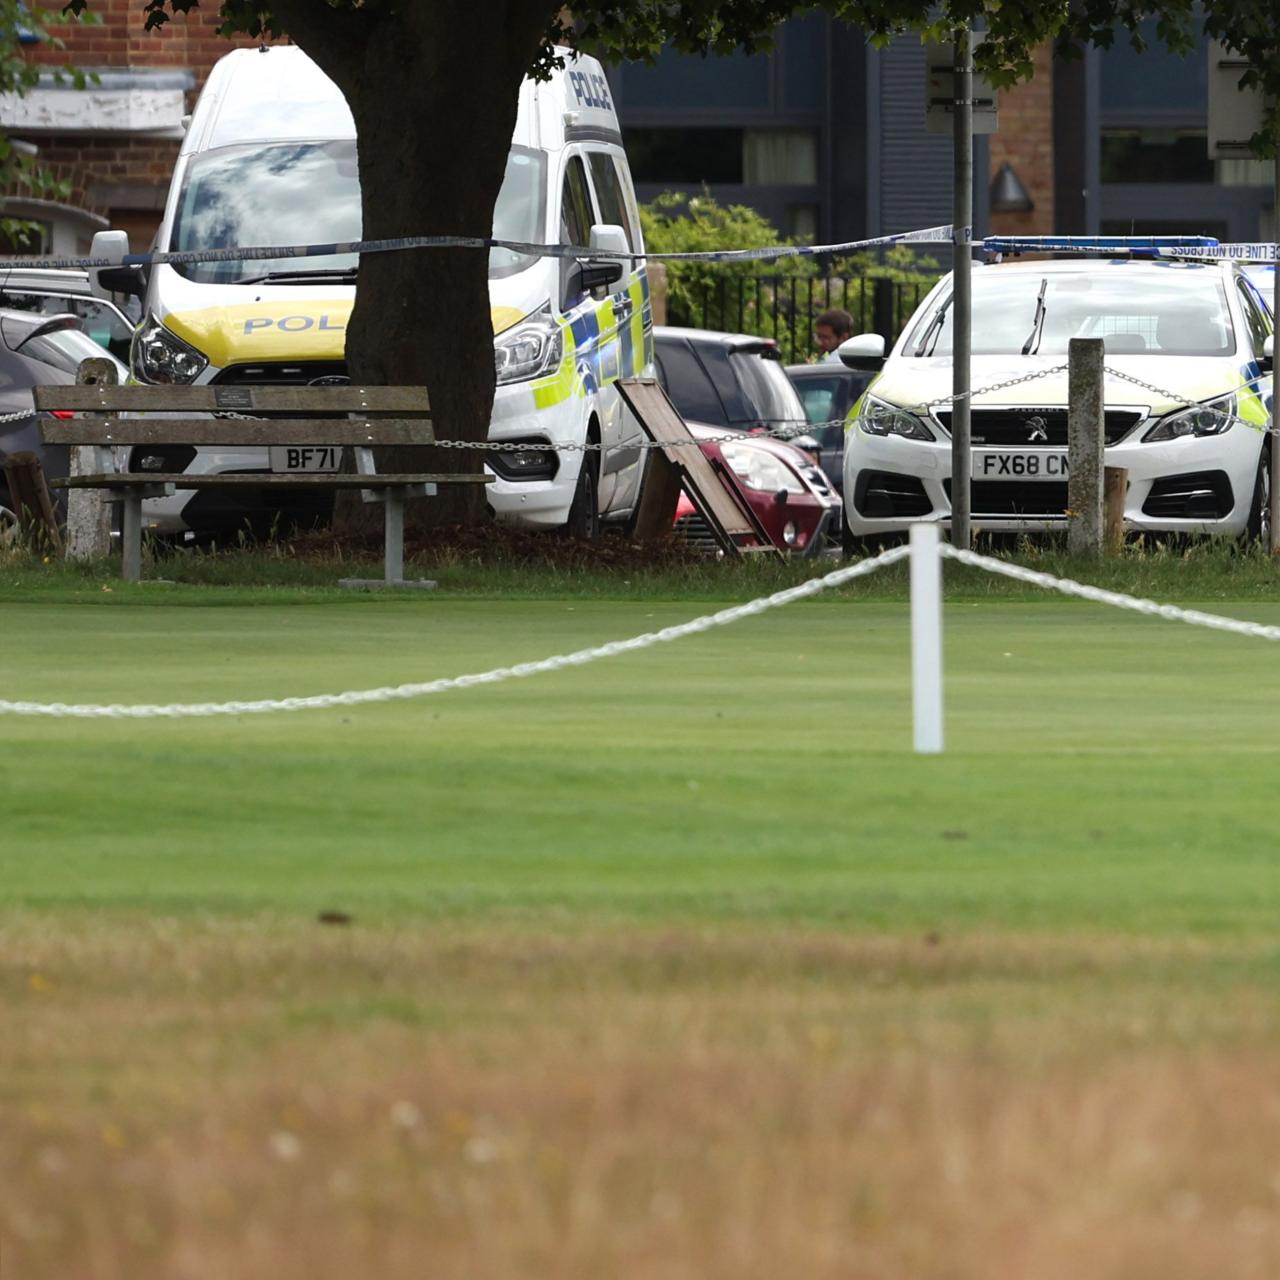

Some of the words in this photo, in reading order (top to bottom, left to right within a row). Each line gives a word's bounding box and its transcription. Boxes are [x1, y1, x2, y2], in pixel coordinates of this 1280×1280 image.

[569, 71, 612, 111] POLICE
[1207, 246, 1226, 257] NOT
[1229, 245, 1243, 257] DO
[1245, 244, 1268, 259] LINE
[244, 314, 345, 335] POL
[287, 448, 335, 468] BF71
[984, 455, 1039, 475] FX68
